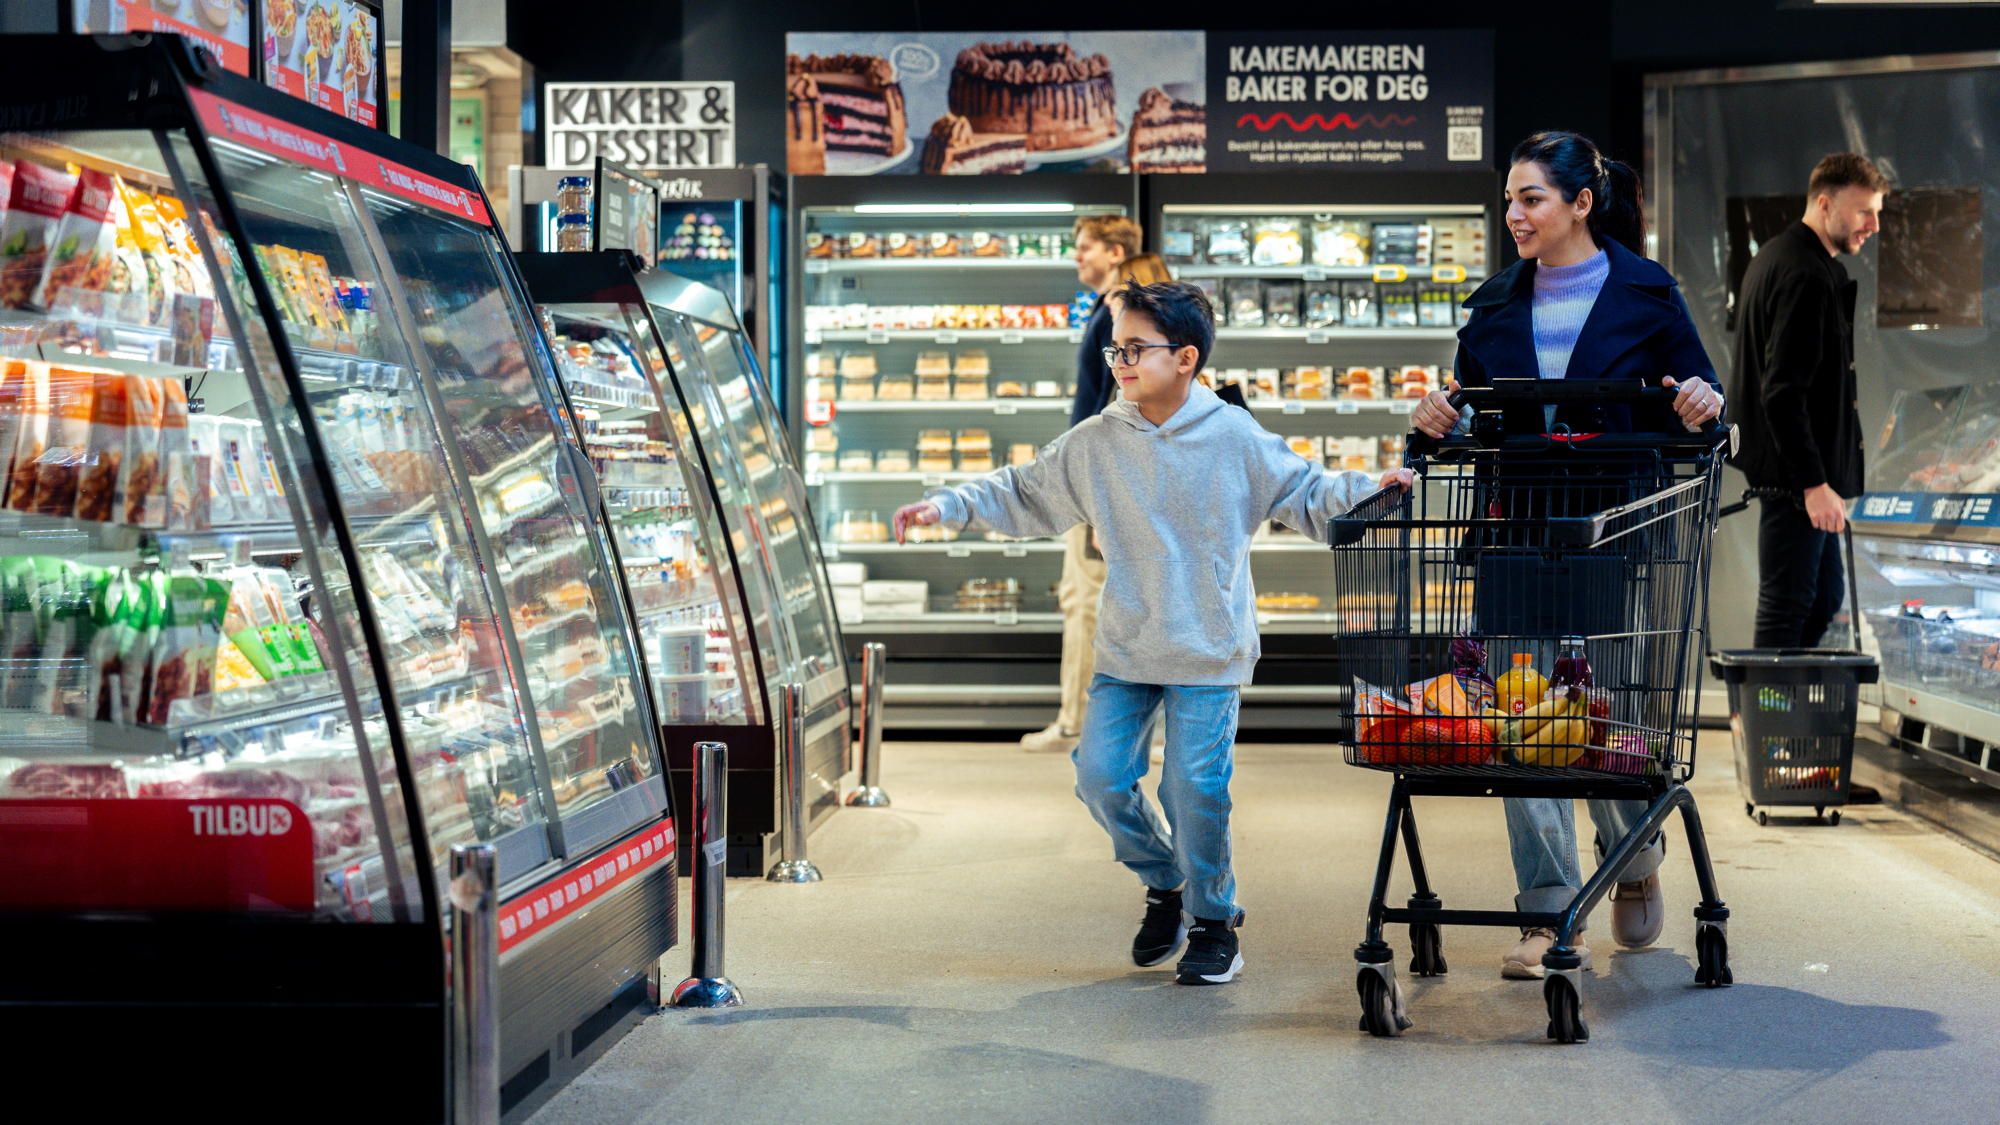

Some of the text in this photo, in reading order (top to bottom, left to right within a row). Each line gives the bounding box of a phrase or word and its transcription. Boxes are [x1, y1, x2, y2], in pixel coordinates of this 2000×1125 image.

[1229, 46, 1424, 72] KAKEMAKEREN
[1226, 75, 1429, 102] BAKER FOR DEG
[552, 87, 730, 124] KAKER &
[564, 129, 721, 166] DESSERT
[188, 804, 293, 836] TILBUD
